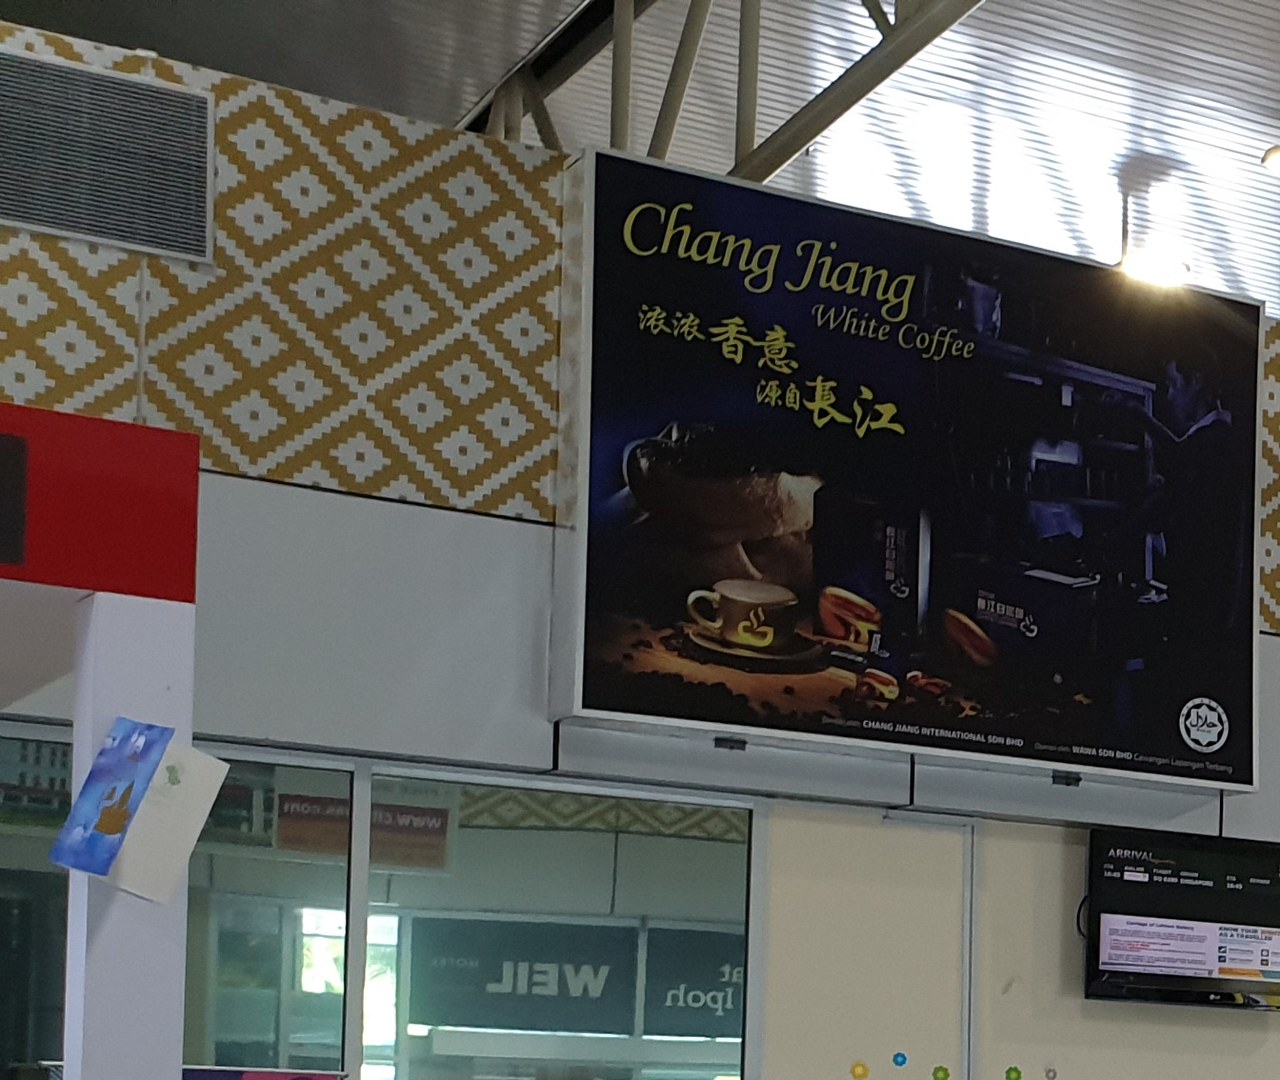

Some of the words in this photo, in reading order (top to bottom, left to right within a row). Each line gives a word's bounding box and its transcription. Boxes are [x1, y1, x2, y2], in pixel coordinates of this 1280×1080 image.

[622, 202, 781, 294] Chang
[785, 239, 917, 322] Jiang
[811, 304, 890, 342] White
[898, 323, 975, 361] Coffee
[862, 720, 894, 732] CHANG
[895, 723, 920, 735] JIANG
[921, 726, 986, 743] INTERNATIONAL
[1108, 848, 1153, 860] ARRIVAL
